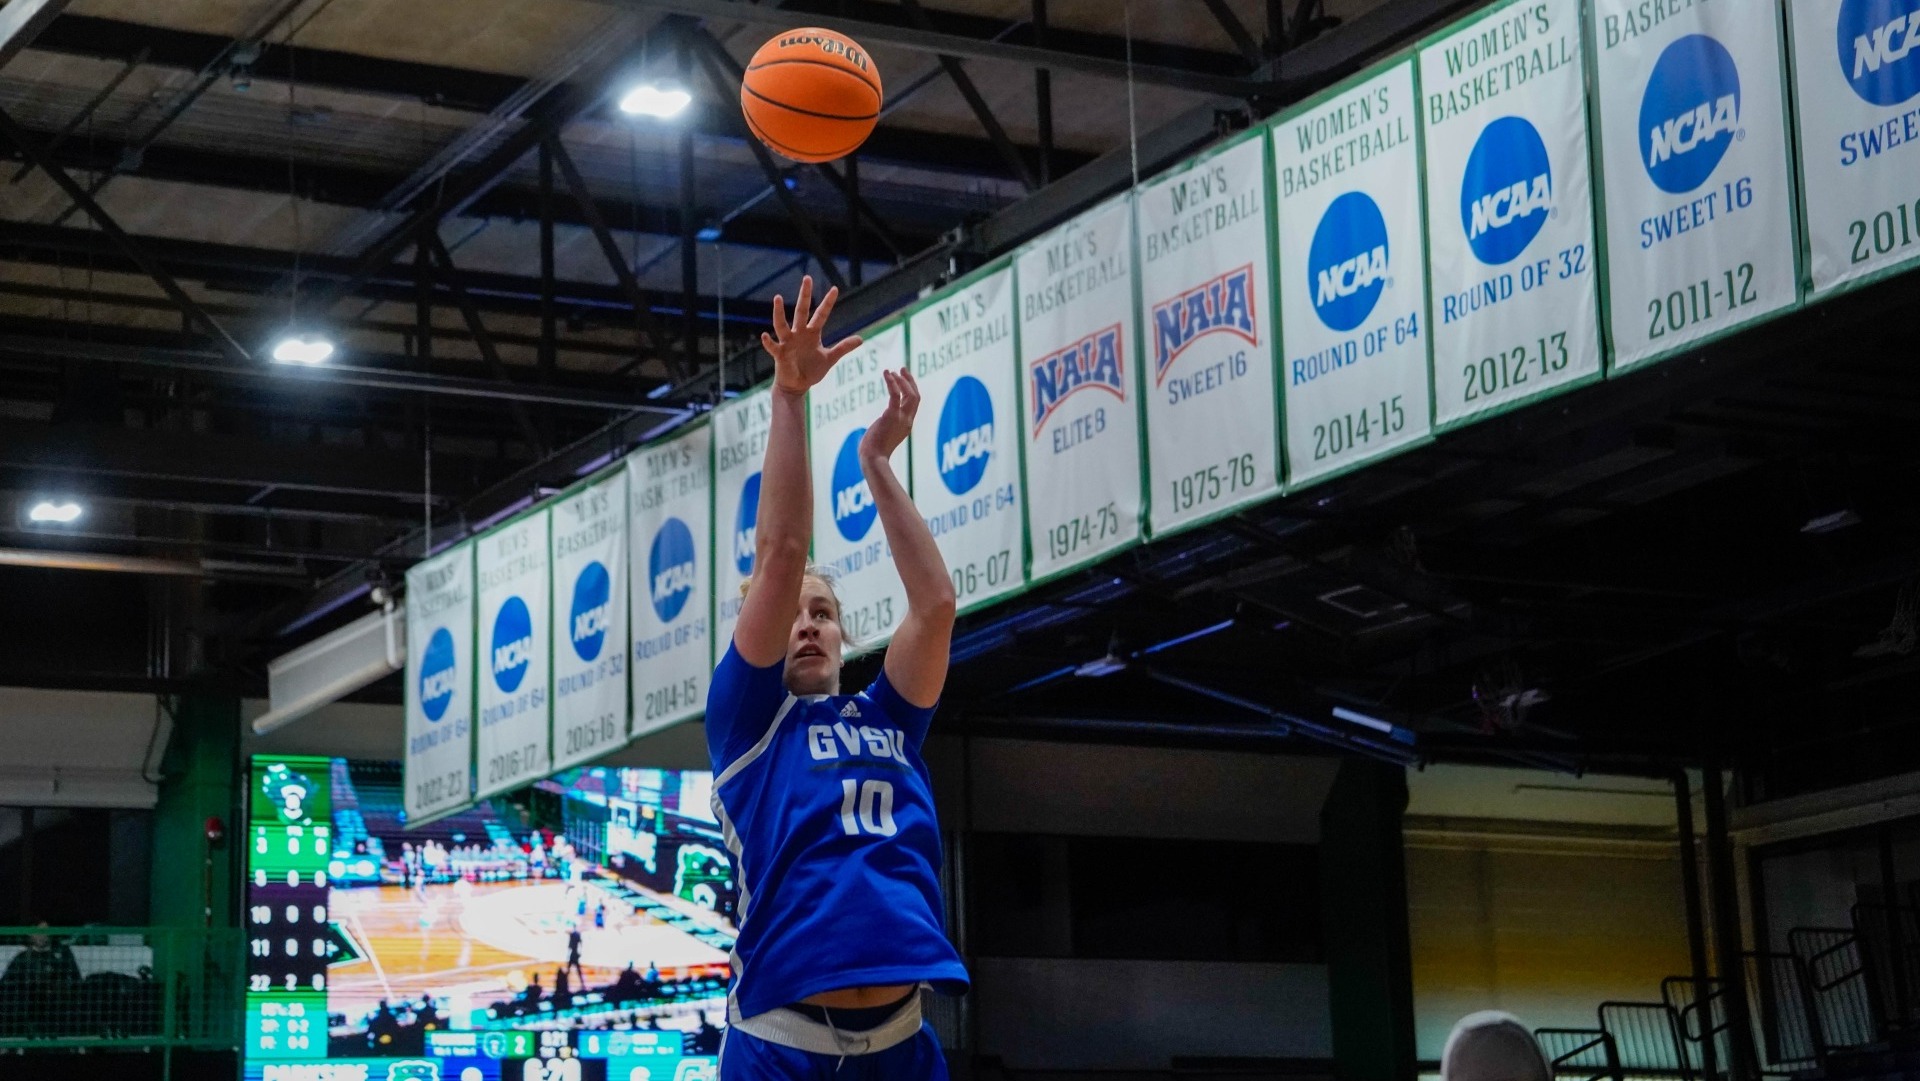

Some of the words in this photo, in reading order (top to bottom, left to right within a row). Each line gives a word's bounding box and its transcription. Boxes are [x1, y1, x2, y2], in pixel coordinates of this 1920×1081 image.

[1445, 3, 1550, 78] WOMEN'S
[1853, 10, 1920, 80] NCA
[1429, 35, 1572, 125] BASKETBALL
[1296, 86, 1389, 154] WOMEN'S
[1650, 93, 1738, 168] NCAA
[1840, 105, 1920, 167] SWEE
[1282, 116, 1409, 199] BASKETBALL
[1170, 166, 1227, 216] MEN'S
[1470, 172, 1550, 241] NCAA
[1640, 192, 1717, 250] SWEET
[1724, 176, 1753, 214] 16
[1046, 229, 1098, 277] MEN'S
[1146, 188, 1259, 263] BASKETBALL
[1025, 253, 1127, 322] BASKETBALL
[1316, 244, 1388, 308] NCAA
[1443, 273, 1513, 324] ROUND
[1521, 258, 1551, 292] OF
[1558, 243, 1587, 280] 32
[1648, 262, 1757, 340] 2011-12
[937, 292, 986, 333] MEN'S
[1154, 272, 1254, 374] NAIA
[835, 349, 879, 387] MEN'S
[917, 314, 1009, 379] BASKETBALL
[1292, 340, 1358, 387] ROUND
[1363, 326, 1388, 358] OF
[1394, 311, 1419, 346] 64
[1463, 330, 1569, 403] 2012-13
[815, 376, 888, 431] BASKETBA
[1033, 330, 1121, 427] NAIA
[1167, 361, 1226, 406] SWEET
[1228, 350, 1248, 381] 16
[941, 422, 993, 475] NCAA
[1052, 414, 1094, 455] ELITE
[1094, 407, 1107, 434] 8
[1313, 395, 1405, 462] 2014-15
[836, 475, 876, 521] NCA
[973, 493, 992, 521] OF
[995, 483, 1015, 512] 64
[1171, 452, 1256, 514] 1975-76
[1048, 501, 1119, 561] 1974-75
[654, 561, 696, 604] NCAA
[952, 549, 1010, 600] 06-07
[493, 636, 532, 676] NCAA
[635, 631, 672, 662] ROUND
[675, 623, 691, 647] OF
[645, 675, 698, 722] 2014-15
[488, 743, 538, 785] 2016-17
[566, 712, 616, 756] 2015-16
[808, 722, 909, 767] GVSU
[841, 778, 898, 837] 10
